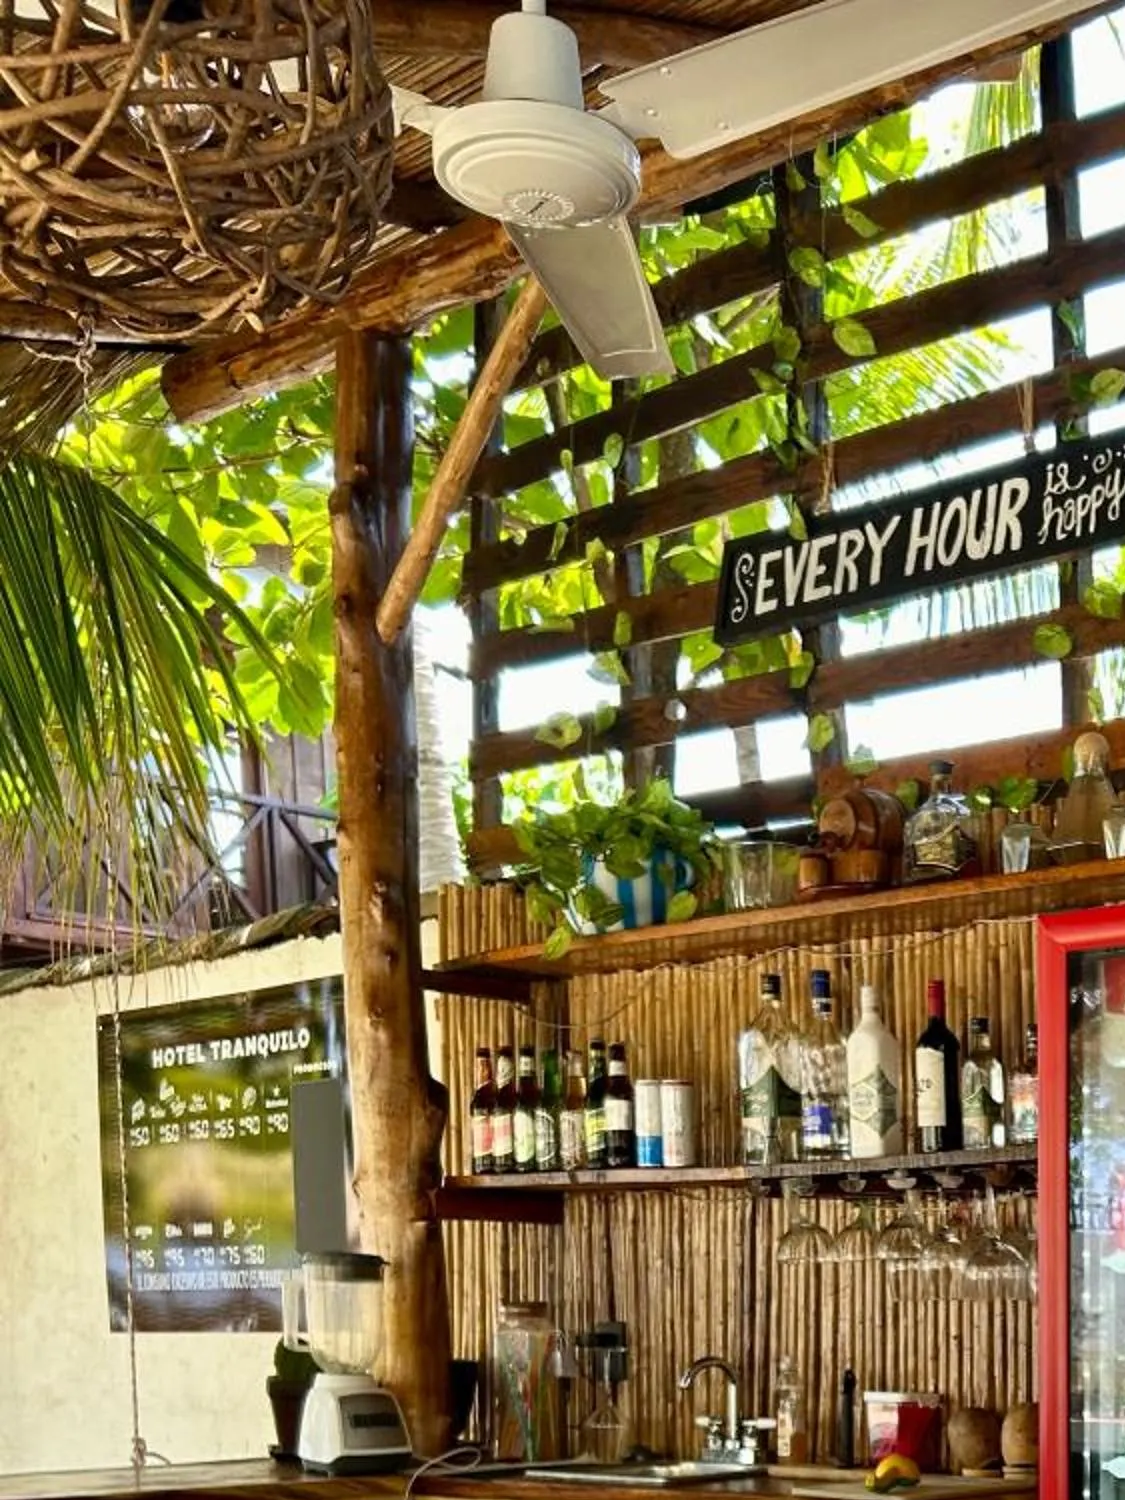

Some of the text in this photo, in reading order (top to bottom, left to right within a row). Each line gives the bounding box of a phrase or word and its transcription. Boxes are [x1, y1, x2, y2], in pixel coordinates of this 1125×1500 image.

[755, 477, 1030, 616] EVERY HOUR
[151, 1029, 311, 1070] HOTEL TRANQUILO
